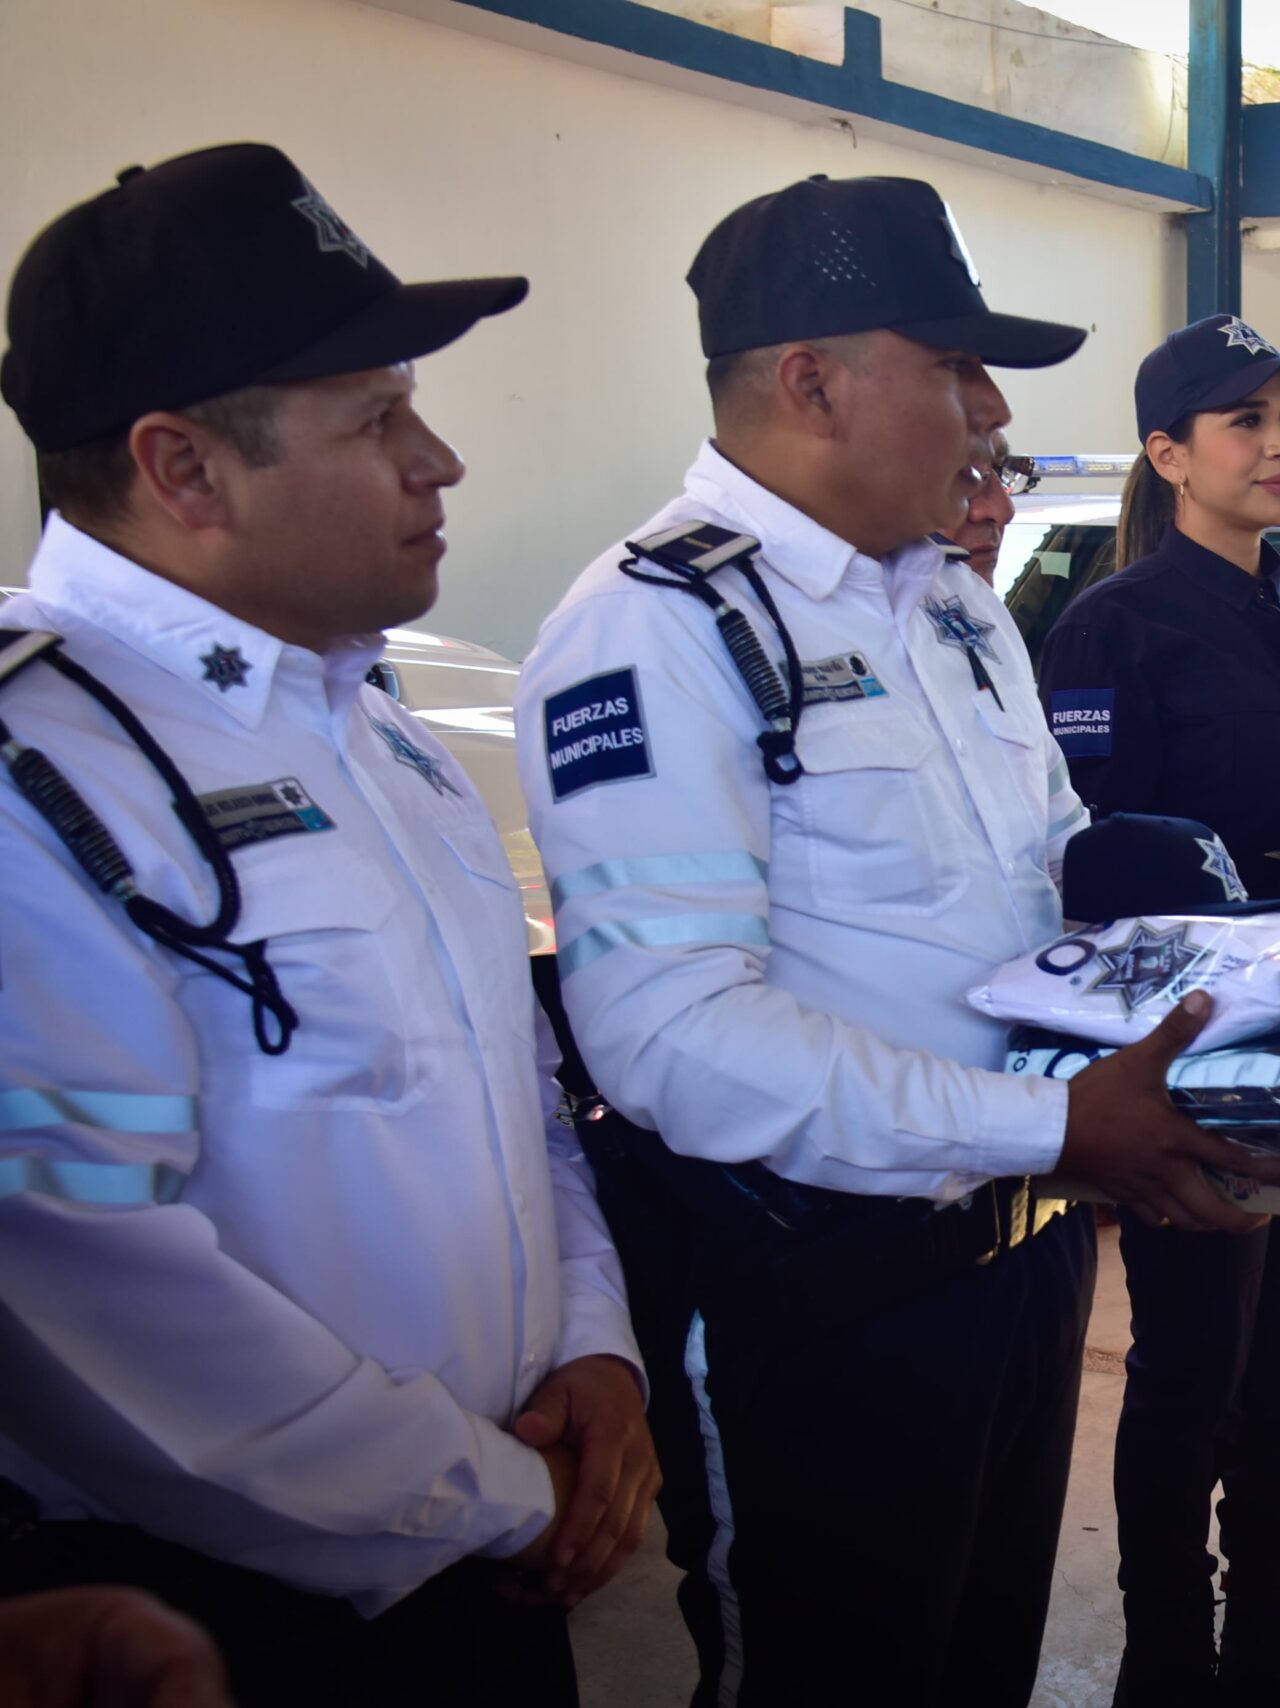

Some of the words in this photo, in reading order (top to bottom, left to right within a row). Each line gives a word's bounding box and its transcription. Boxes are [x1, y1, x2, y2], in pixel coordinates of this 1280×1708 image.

[552, 696, 630, 737] FUERZAS
[1052, 709, 1111, 724] FUERZAS
[1052, 724, 1110, 736] MUNICIPALES
[550, 726, 644, 770] MUNICIPALES
